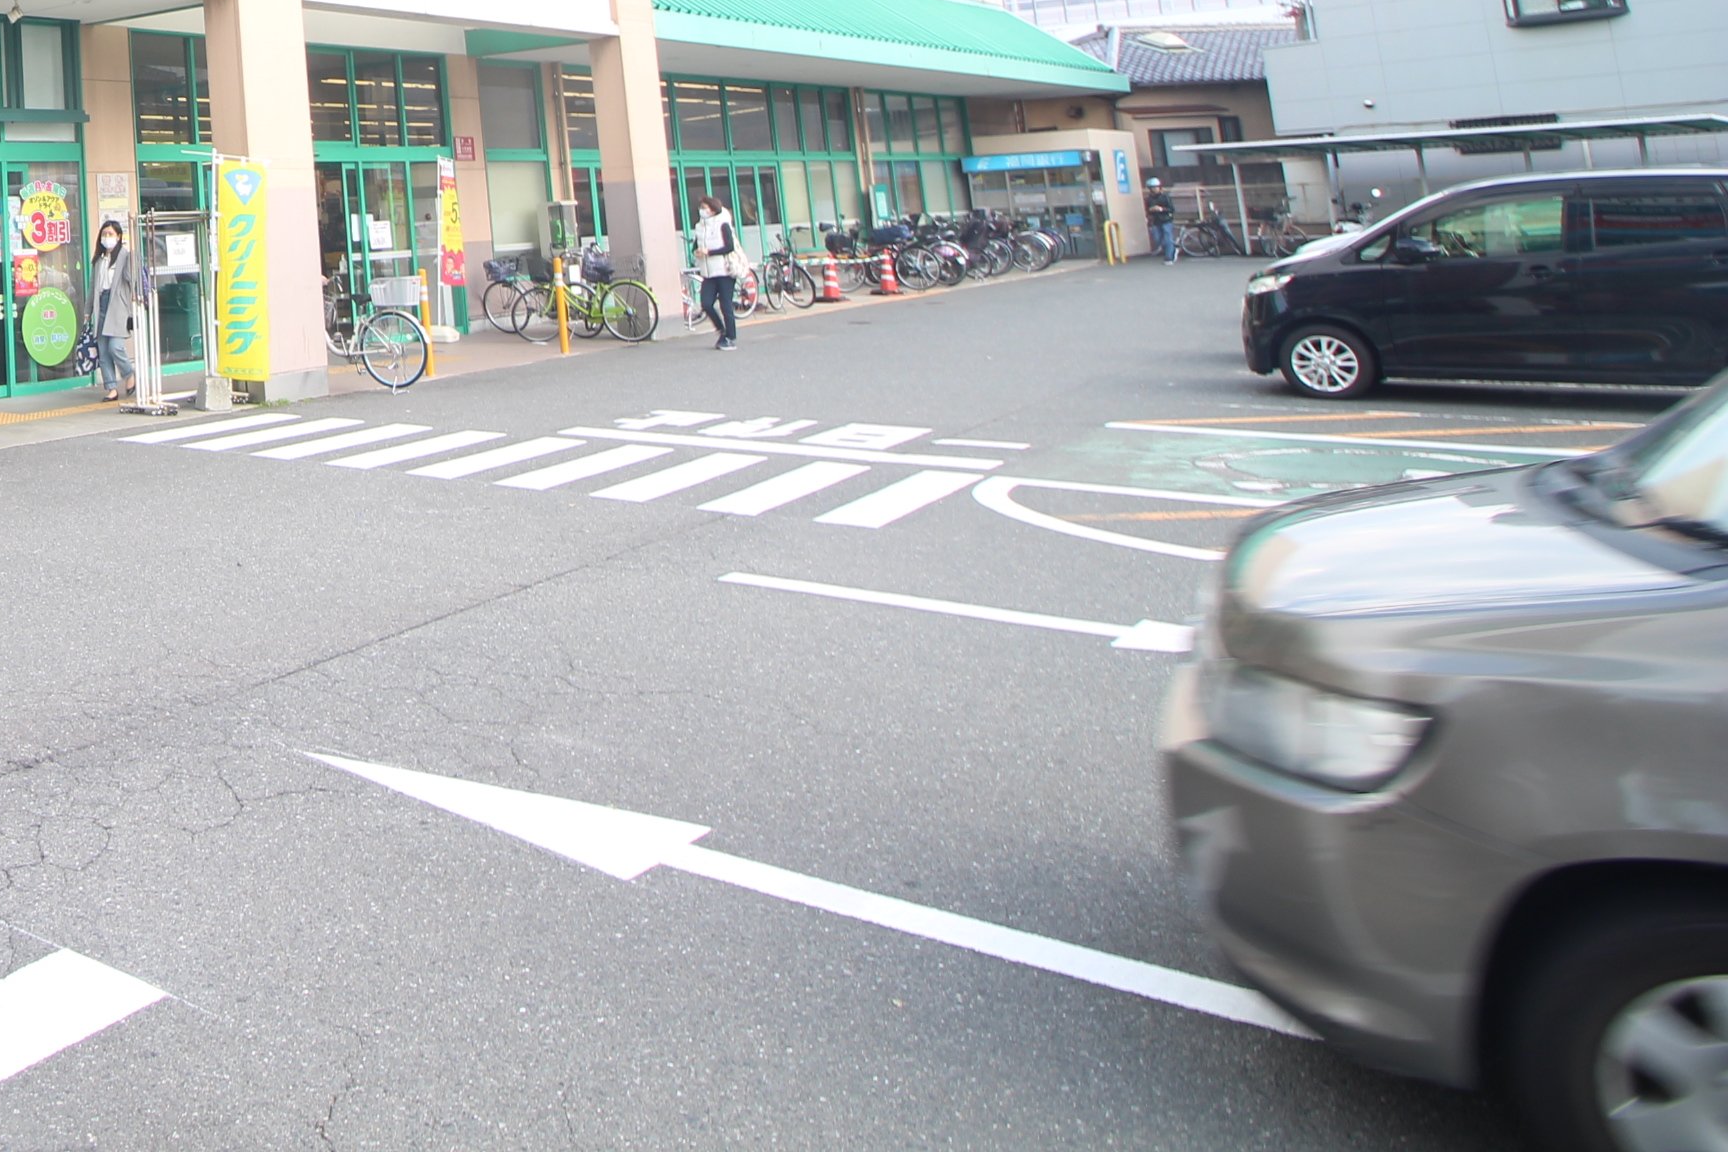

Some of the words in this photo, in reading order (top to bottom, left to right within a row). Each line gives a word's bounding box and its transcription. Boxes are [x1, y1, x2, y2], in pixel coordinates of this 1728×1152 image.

[31, 211, 71, 244] 3割引
[225, 213, 259, 356] クリーニング
